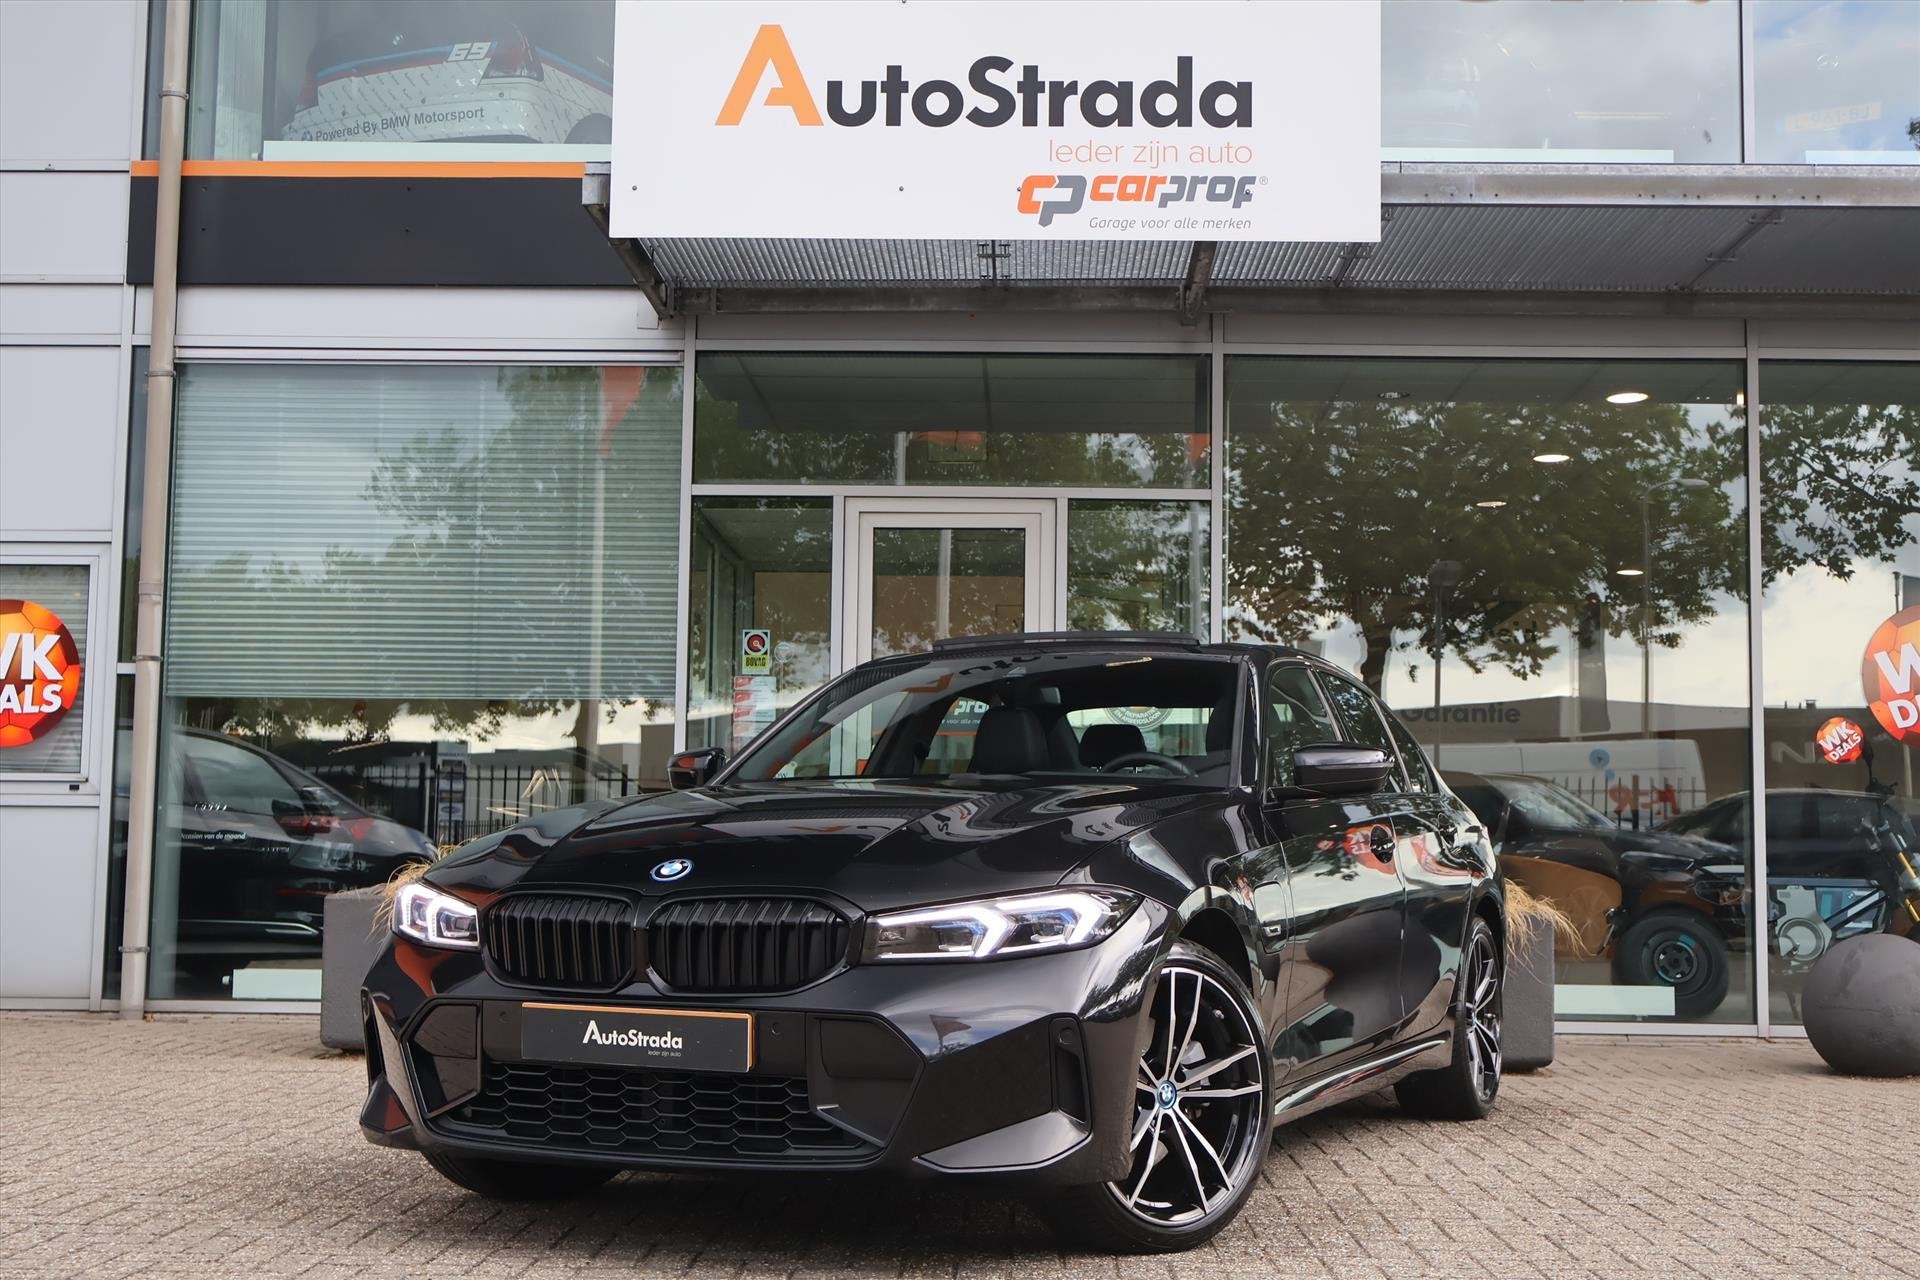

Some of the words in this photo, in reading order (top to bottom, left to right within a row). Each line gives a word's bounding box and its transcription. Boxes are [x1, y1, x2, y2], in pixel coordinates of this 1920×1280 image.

[448, 42, 491, 61] 69
[715, 24, 1252, 128] AutoStrada
[315, 120, 361, 141] Powered
[363, 121, 377, 135] By
[381, 115, 410, 130] BMW
[414, 107, 485, 124] Motorsport
[1049, 140, 1124, 163] Ieder
[1133, 141, 1178, 169] zijn
[1188, 142, 1252, 164] auto
[1090, 175, 1256, 209] carprof
[1089, 217, 1136, 230] Garage
[1141, 219, 1170, 228] voor
[1174, 217, 1198, 229] alle
[1202, 217, 1251, 229] merken
[1818, 721, 1856, 751] WK
[1829, 733, 1862, 761] DEALS
[583, 1020, 682, 1049] AutoStrada
